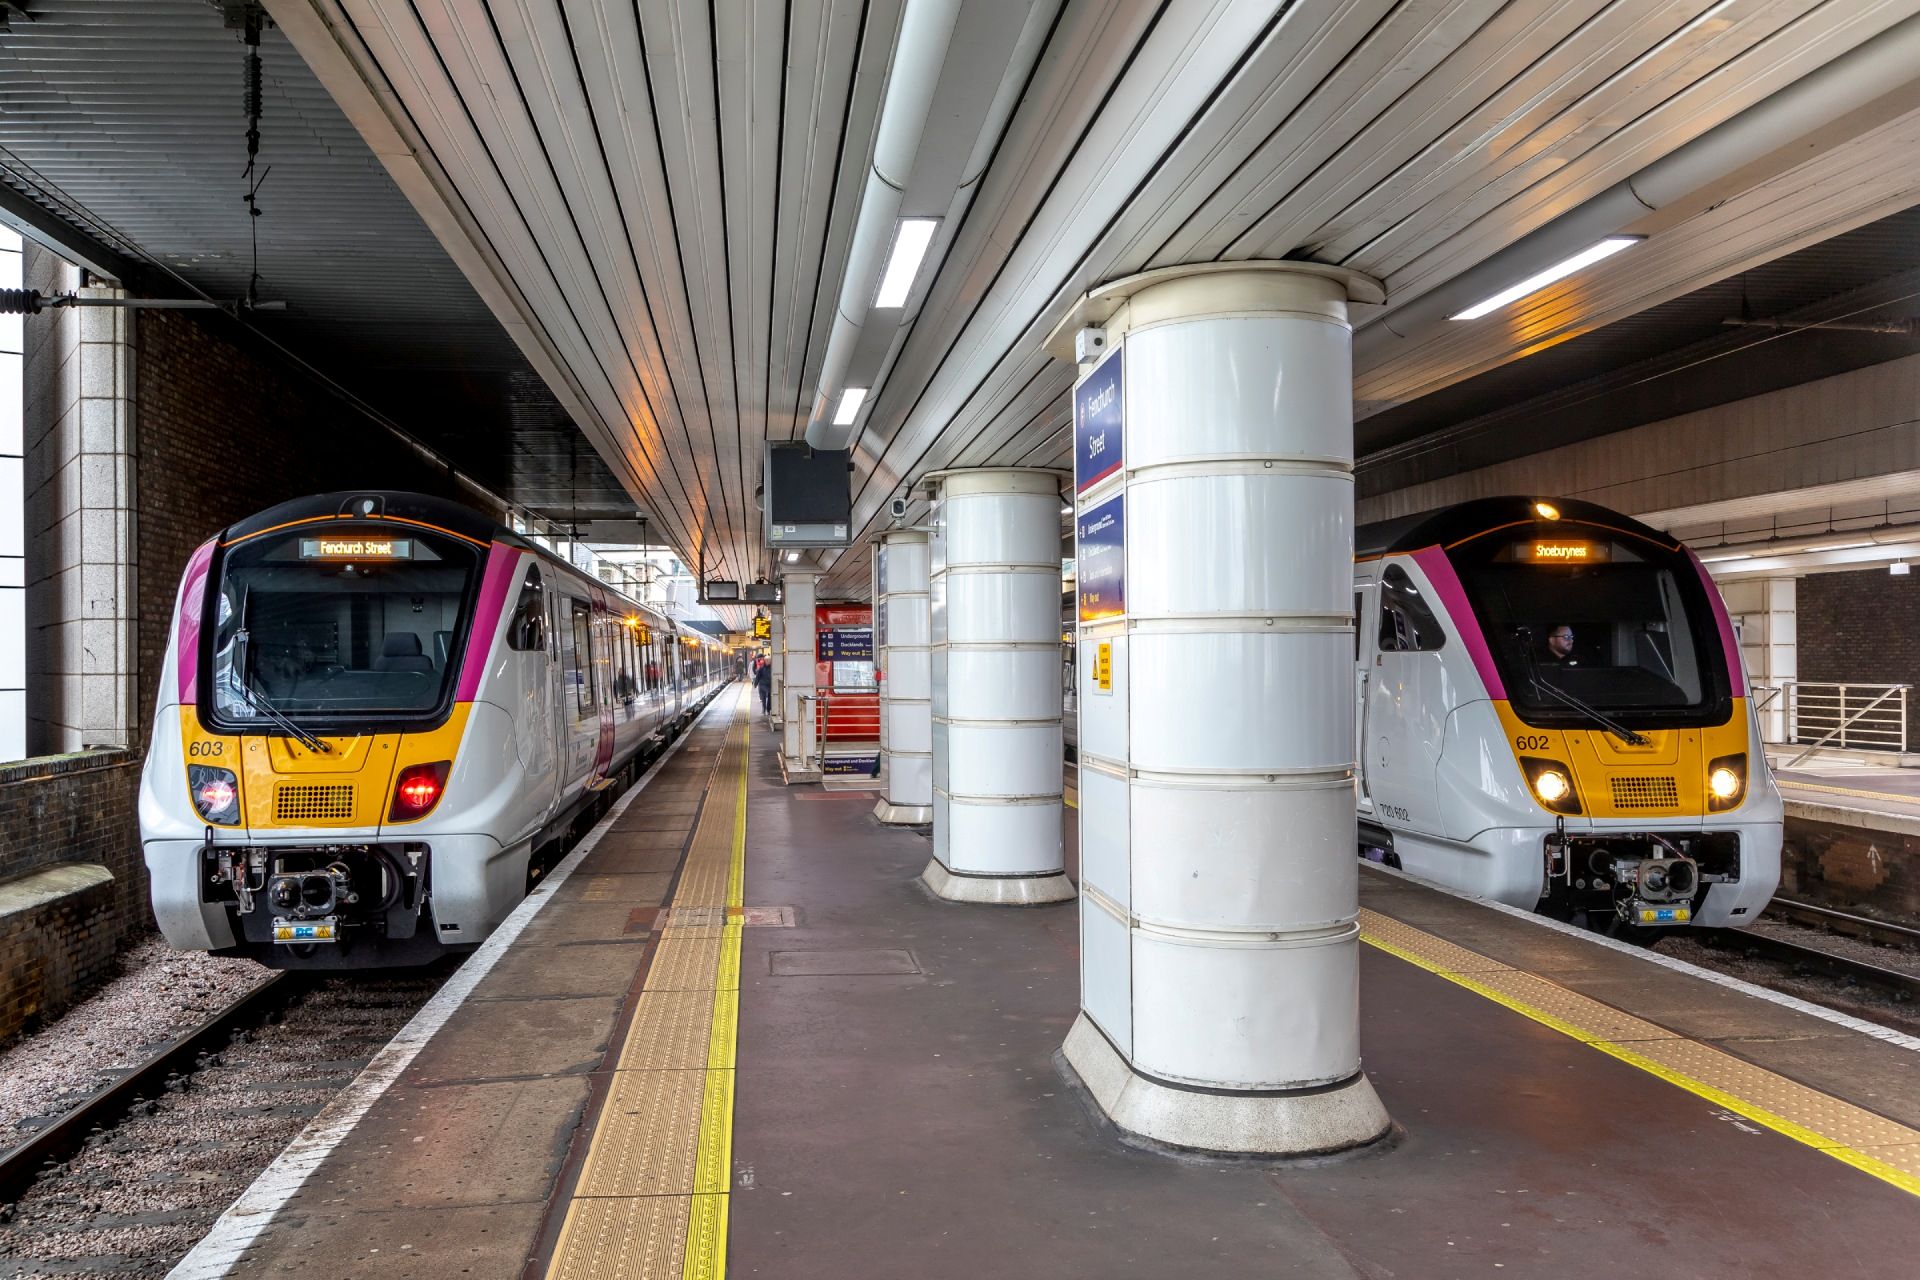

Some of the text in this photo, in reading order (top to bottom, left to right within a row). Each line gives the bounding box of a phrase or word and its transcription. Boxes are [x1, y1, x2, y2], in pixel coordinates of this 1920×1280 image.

[1088, 378, 1115, 420] Fenchurch
[1089, 429, 1105, 460] Street
[320, 541, 392, 555] Fenchurch Street
[1536, 545, 1587, 559] Shoeburyness
[189, 741, 223, 757] 603
[1516, 735, 1550, 751] 602
